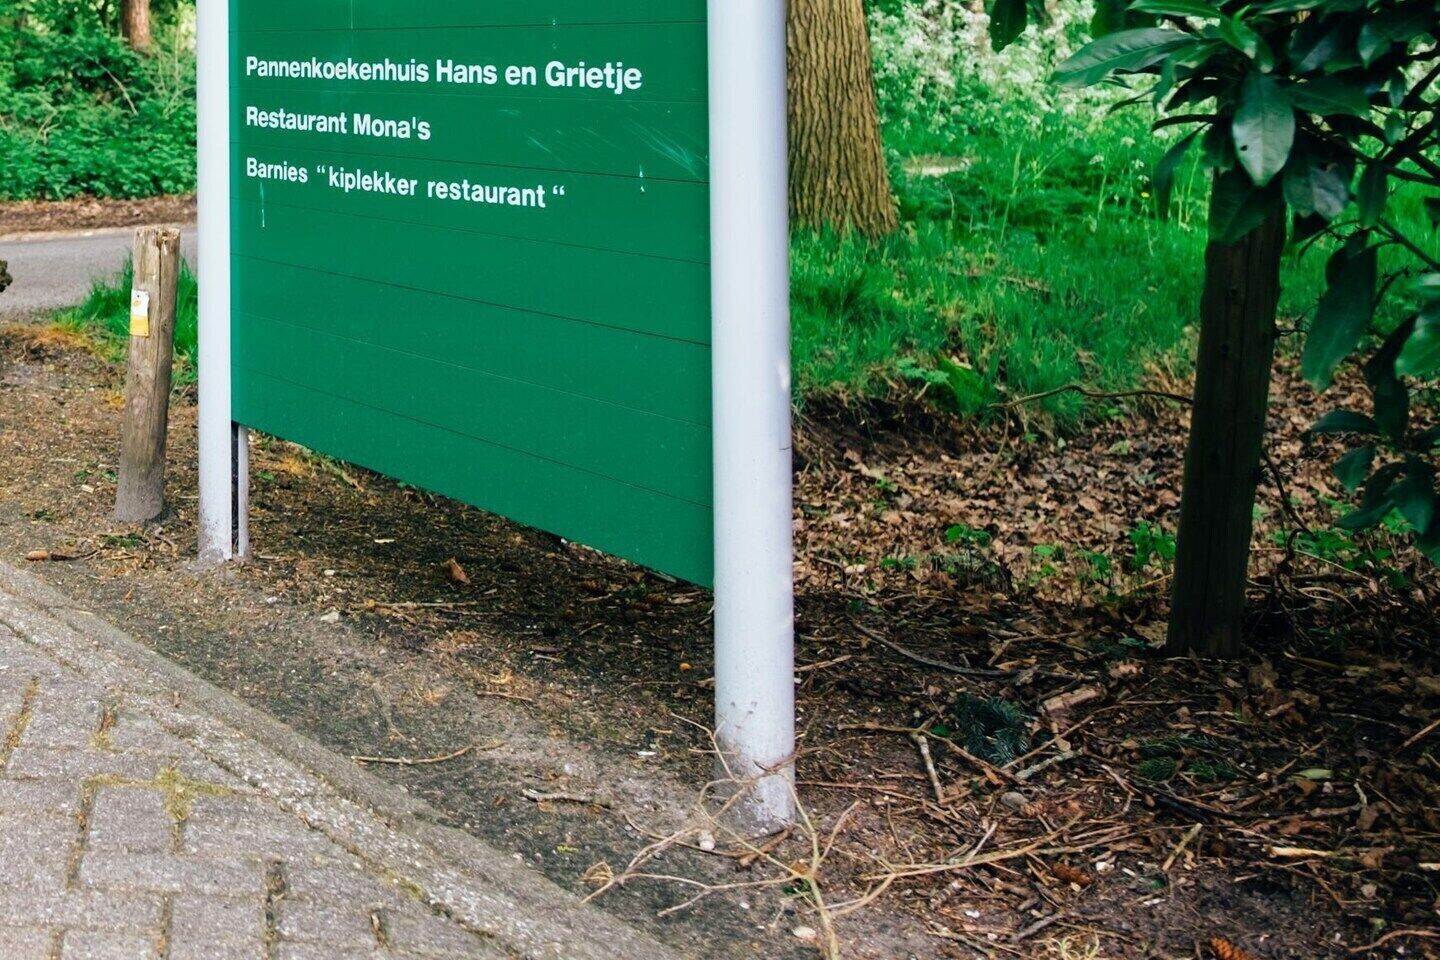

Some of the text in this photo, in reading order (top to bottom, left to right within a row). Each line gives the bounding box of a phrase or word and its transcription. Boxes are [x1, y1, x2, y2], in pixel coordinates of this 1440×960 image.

[246, 56, 642, 95] Pannenkoekenhuis Hans en Grietje
[246, 106, 431, 141] Restaurant Mona's
[246, 157, 308, 183] Barnies
